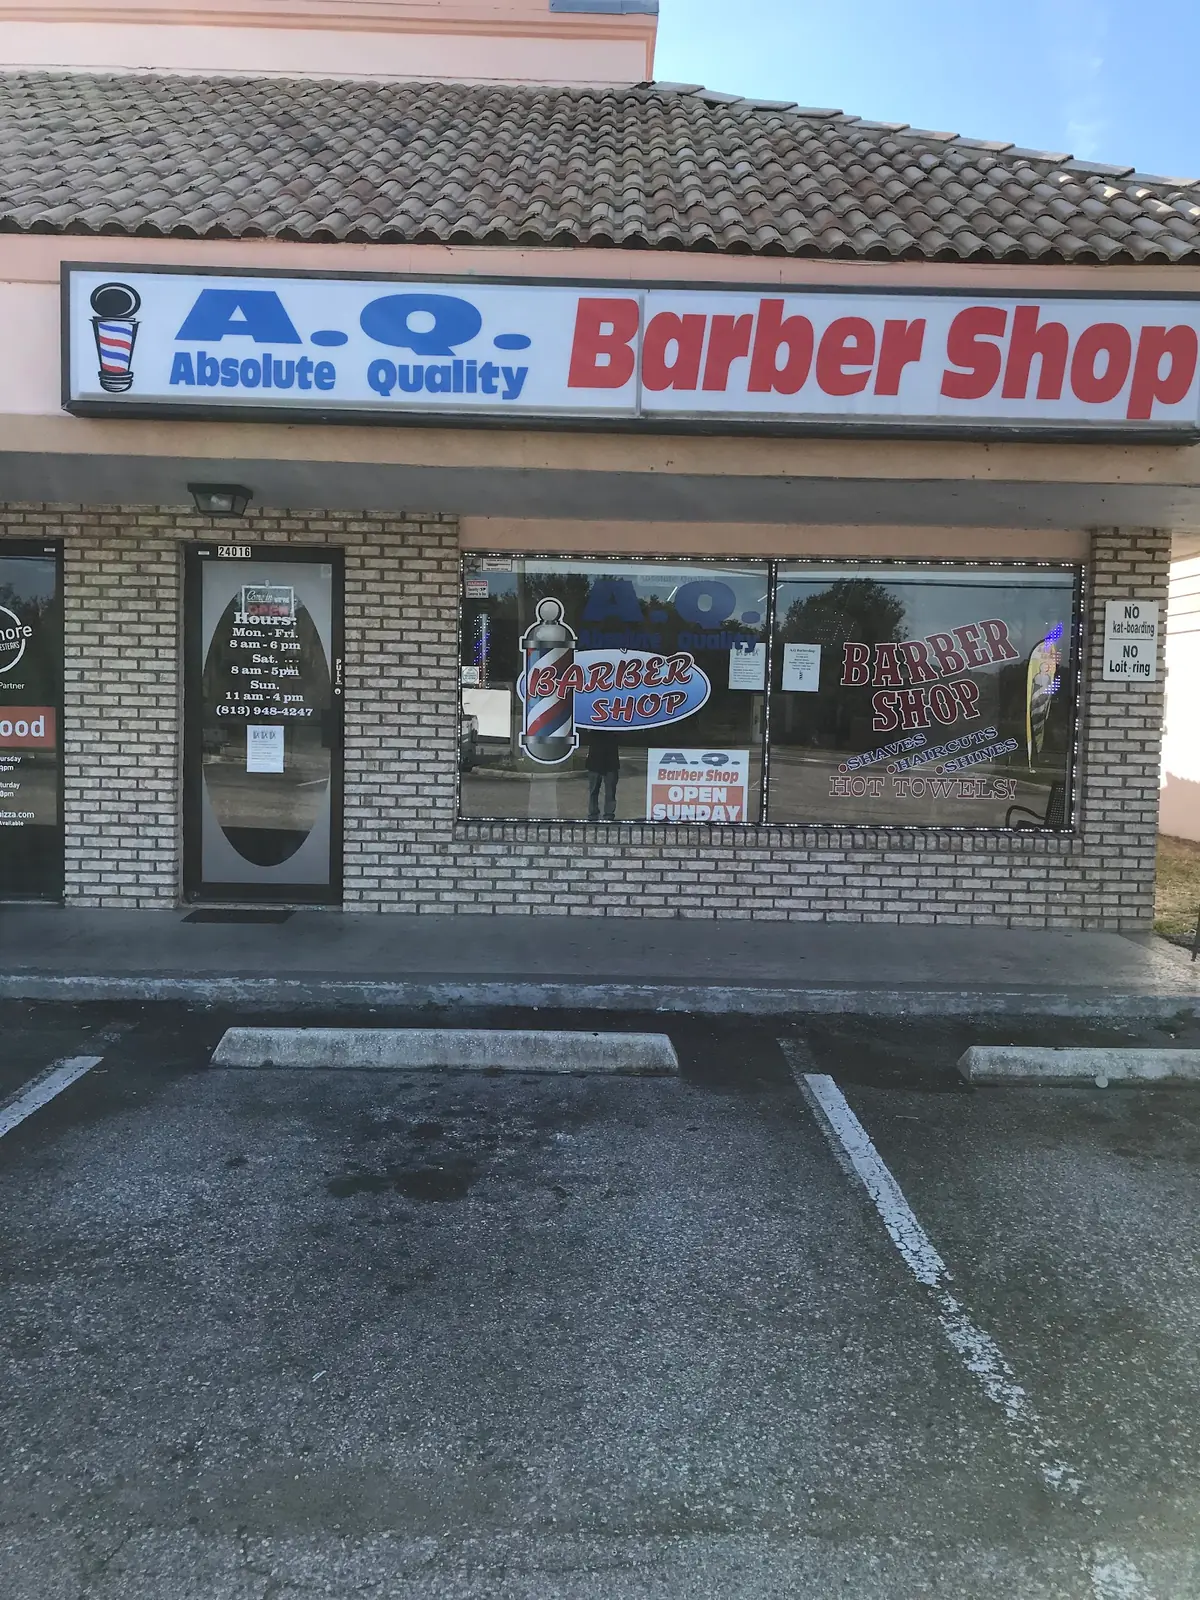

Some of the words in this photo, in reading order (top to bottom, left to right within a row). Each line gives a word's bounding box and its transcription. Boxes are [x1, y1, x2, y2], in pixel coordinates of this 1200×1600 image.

[174, 288, 532, 357] A.Q.
[567, 297, 926, 396] Barber
[940, 305, 1199, 420] Shop
[169, 351, 336, 391] Absolute
[367, 359, 528, 400] Quality
[218, 546, 251, 557] 24016
[248, 604, 289, 616] OPEN
[582, 578, 761, 630] A.Q.
[1124, 606, 1140, 619] NO
[233, 611, 297, 625] Hours:
[232, 627, 265, 637] Mon.
[274, 629, 299, 638] Fri.
[677, 629, 758, 652] Quality
[229, 640, 238, 649] 8
[240, 641, 261, 649] am
[270, 641, 278, 649] 6
[280, 643, 301, 651] pm
[840, 618, 1020, 687] BARBER
[1122, 645, 1139, 658] NO
[252, 654, 278, 663] Sat.
[231, 665, 239, 675] 8
[241, 667, 262, 675] am
[335, 658, 343, 685] PULL
[528, 652, 693, 699] BARBER
[250, 680, 280, 690] Sun.
[225, 692, 240, 700] 11
[243, 693, 264, 701] am
[272, 693, 281, 701] 4
[283, 695, 304, 703] pm
[590, 691, 688, 722] SHOP
[872, 679, 980, 731] SHOP
[216, 705, 250, 717] (813)
[253, 706, 313, 717] 948-4247
[847, 733, 927, 770] SHAVES
[895, 726, 998, 773] HAIRCUTS
[943, 738, 1019, 773] SHINES
[659, 753, 741, 766] A.Q.
[658, 768, 704, 781] Barber
[705, 770, 740, 784] Shop
[668, 785, 727, 803] OPEN
[828, 776, 885, 798] HOT
[893, 777, 1018, 800] TOWELS!
[652, 803, 741, 822] SUNDAY
